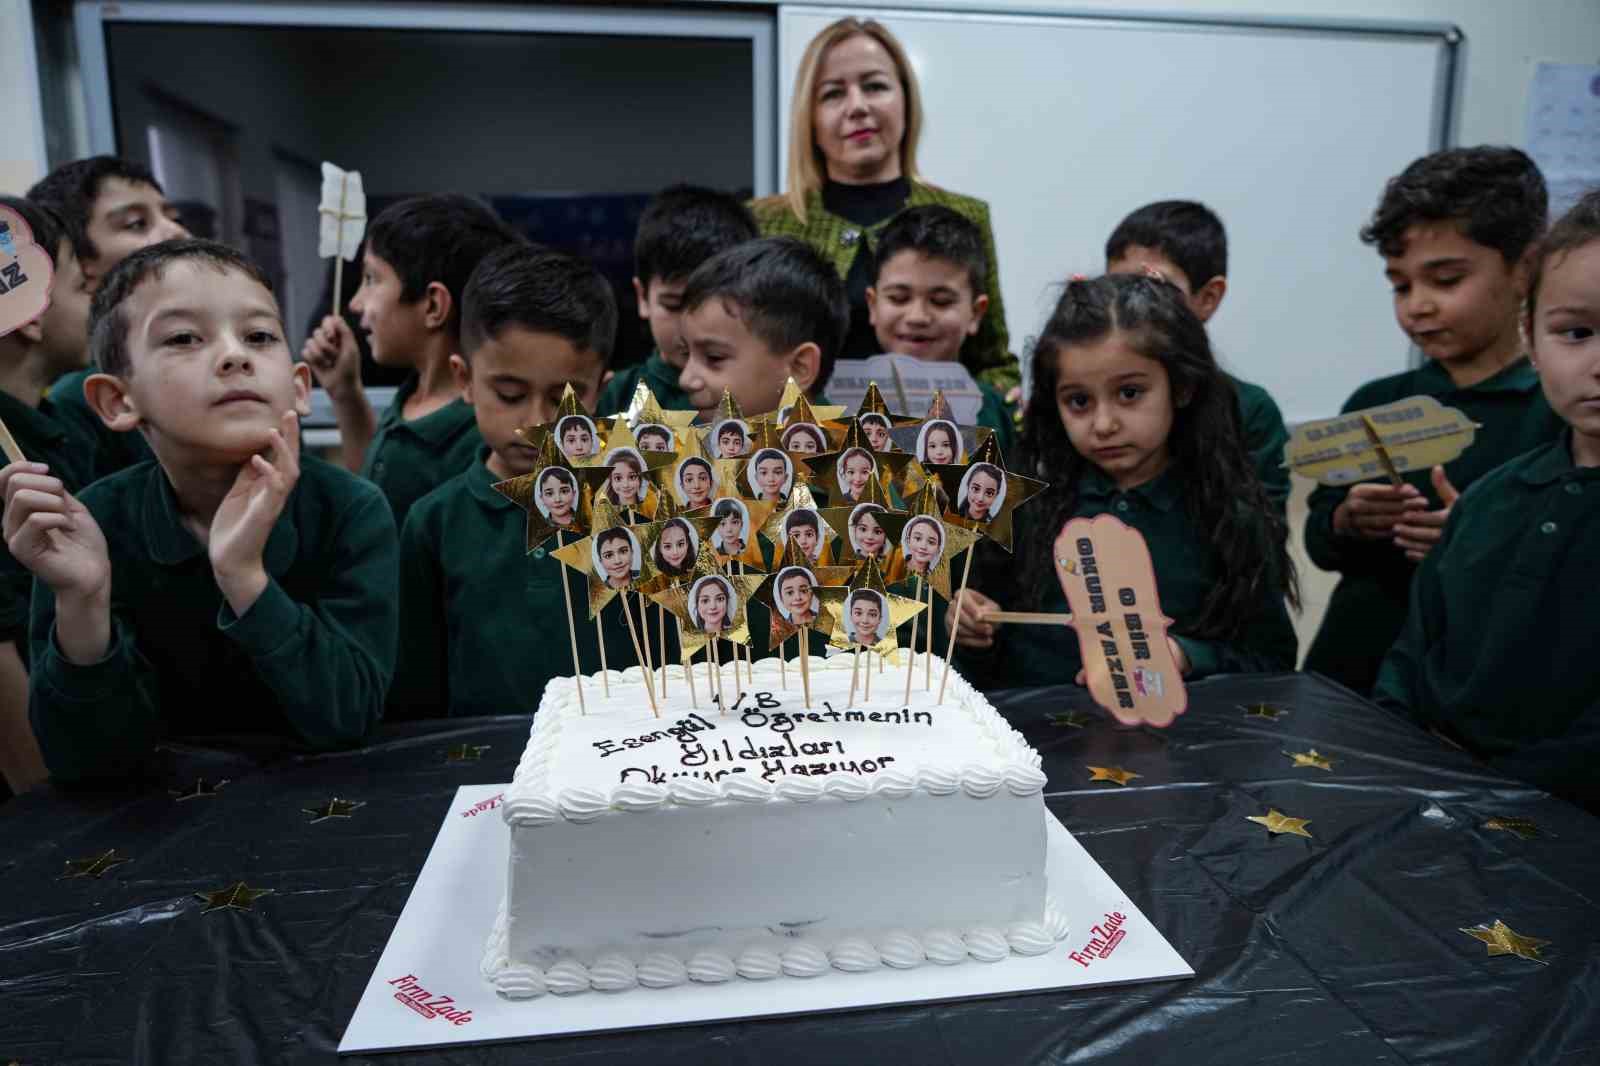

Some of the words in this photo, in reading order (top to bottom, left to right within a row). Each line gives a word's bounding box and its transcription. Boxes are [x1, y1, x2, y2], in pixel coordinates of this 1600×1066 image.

[1076, 537, 1106, 614] OKUR
[1096, 621, 1135, 709] YAZAR
[1118, 587, 1136, 607] O
